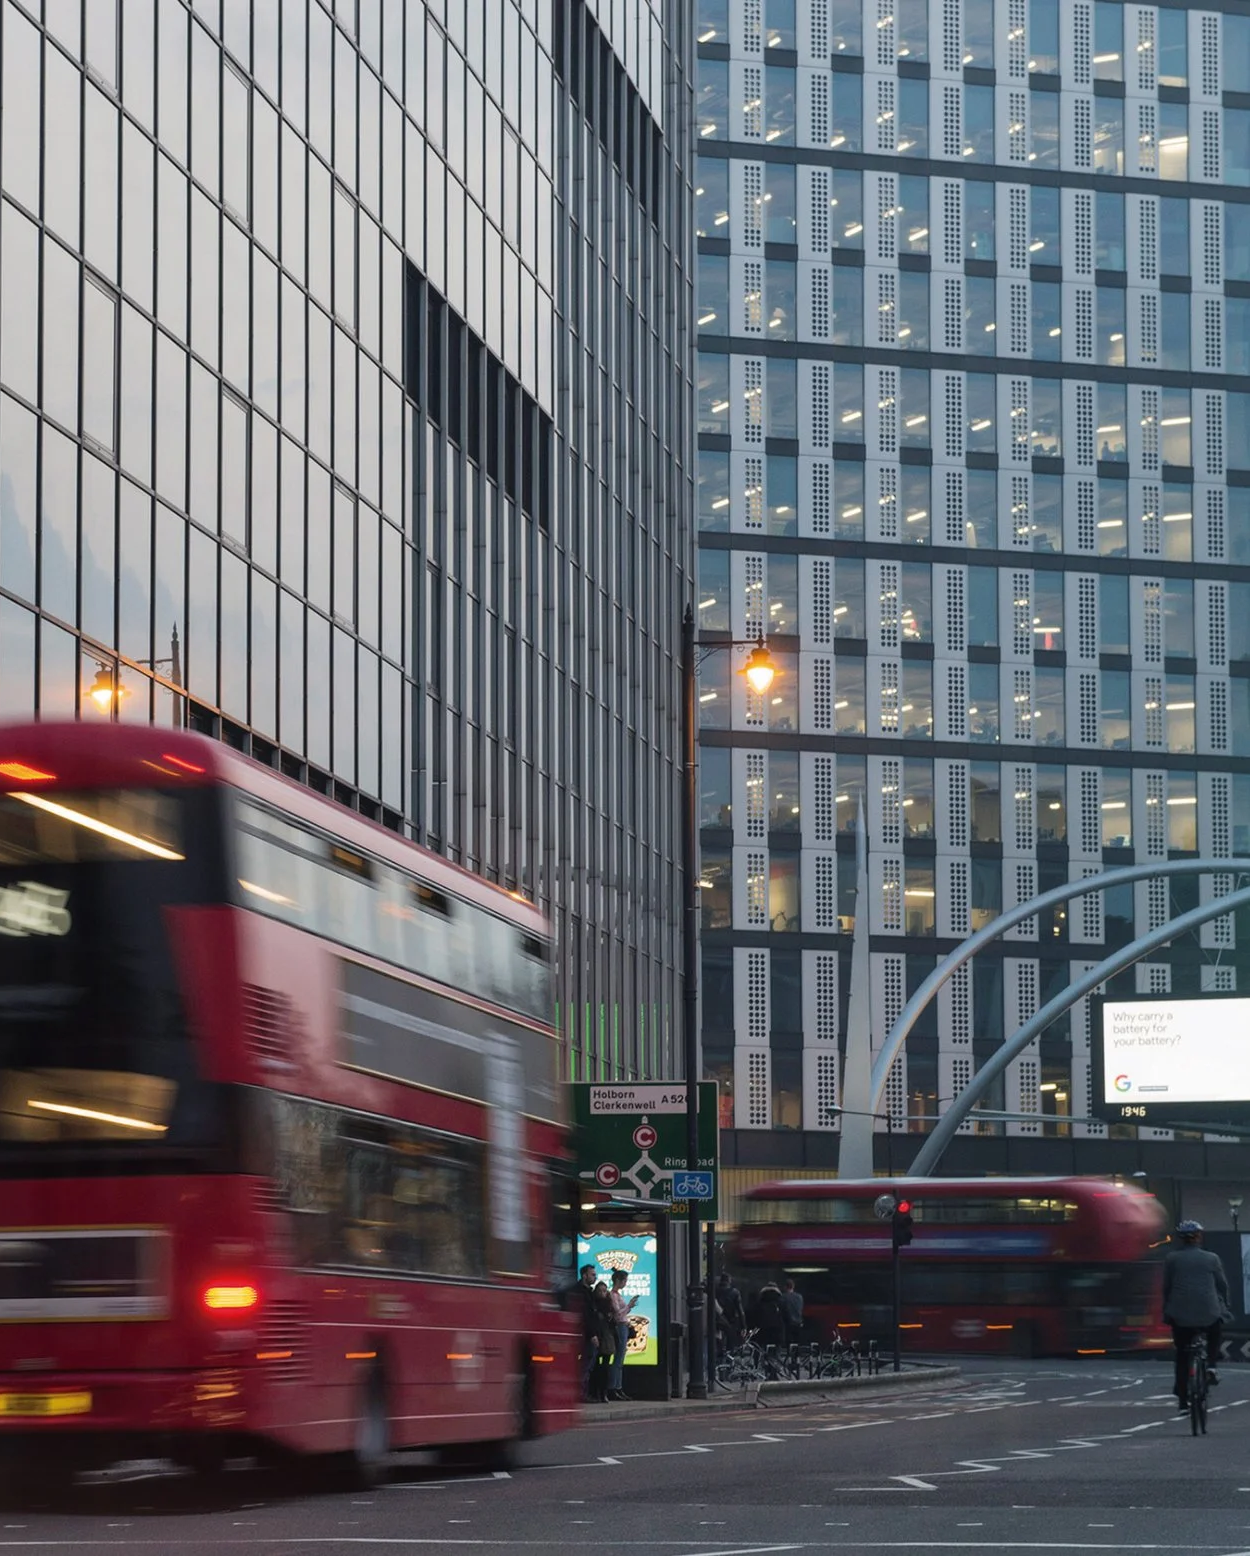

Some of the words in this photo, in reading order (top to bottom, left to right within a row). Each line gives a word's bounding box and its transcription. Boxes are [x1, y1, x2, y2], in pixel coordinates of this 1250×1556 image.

[1112, 1012, 1136, 1023] Why
[1138, 1012, 1164, 1022] carry
[1167, 1012, 1173, 1020] a
[1113, 1024, 1150, 1035] battery
[1152, 1024, 1168, 1033] for
[1113, 1038, 1135, 1048] your
[1138, 1034, 1182, 1047] battery?
[593, 1090, 635, 1099] Holborn
[593, 1101, 656, 1110] Clerkenwell
[664, 1157, 687, 1168] Ring
